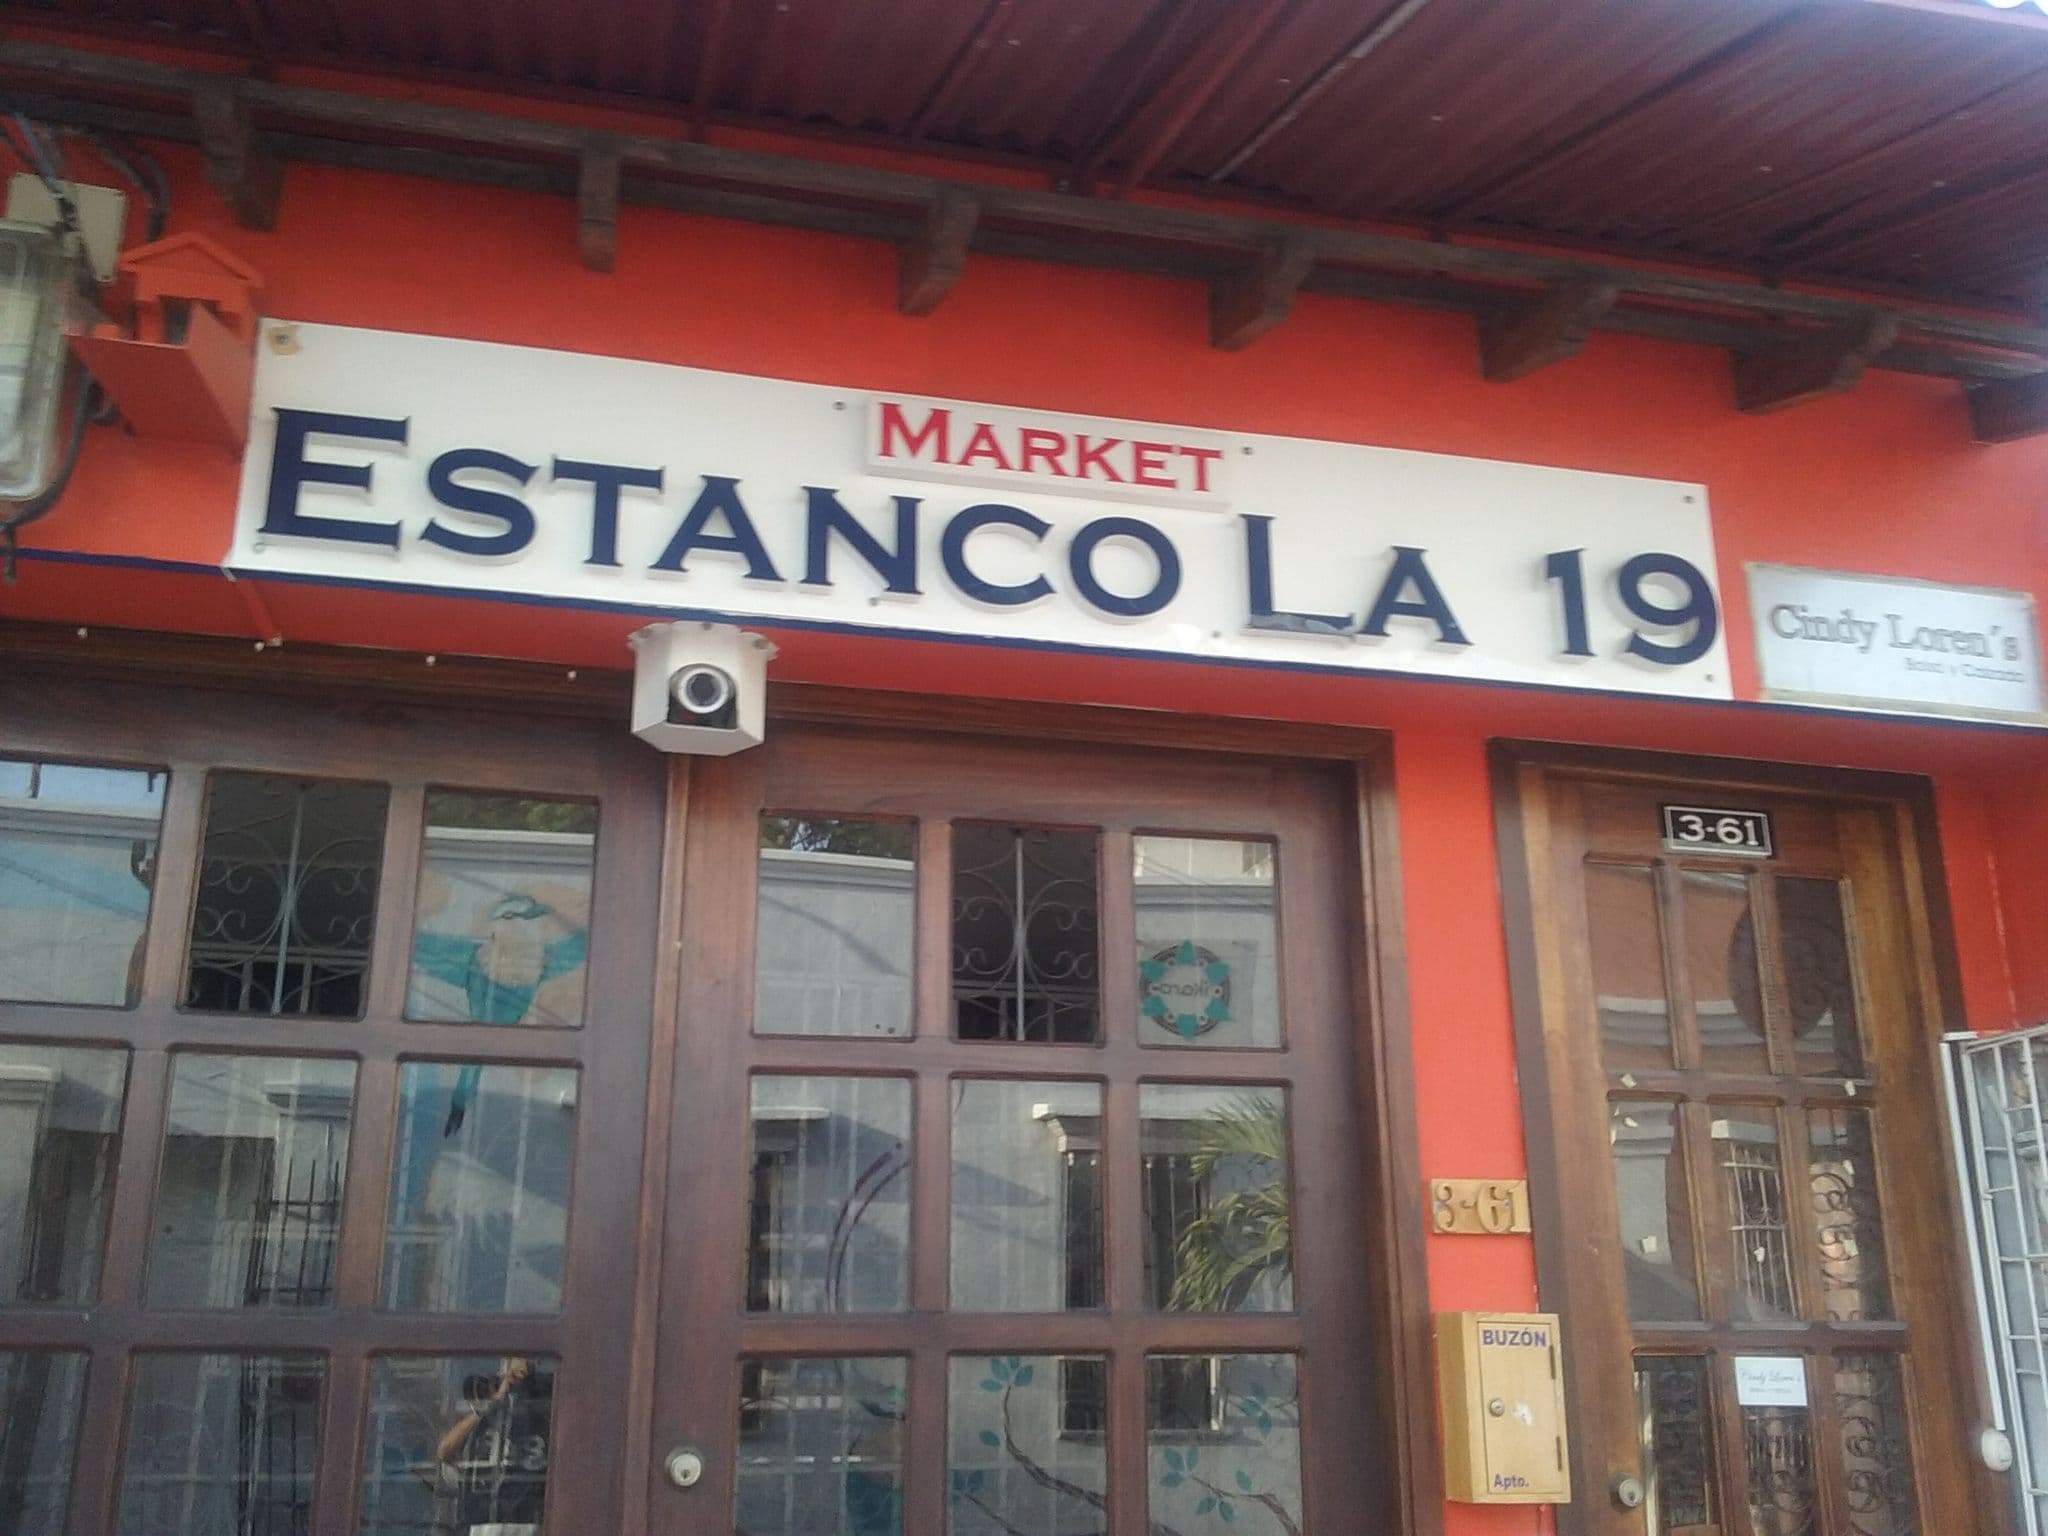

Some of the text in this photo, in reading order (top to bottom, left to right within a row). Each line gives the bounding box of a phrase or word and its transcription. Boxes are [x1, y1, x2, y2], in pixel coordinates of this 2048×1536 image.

[878, 402, 1224, 492] MARKET
[258, 406, 1718, 665] ESTANCO LA 19
[1769, 603, 1877, 654] Cindy
[1678, 814, 1760, 846] 3-61
[1434, 1180, 1532, 1233] 3-61
[1482, 1327, 1548, 1348] BUZÓN
[1493, 1473, 1530, 1490] Apto.
